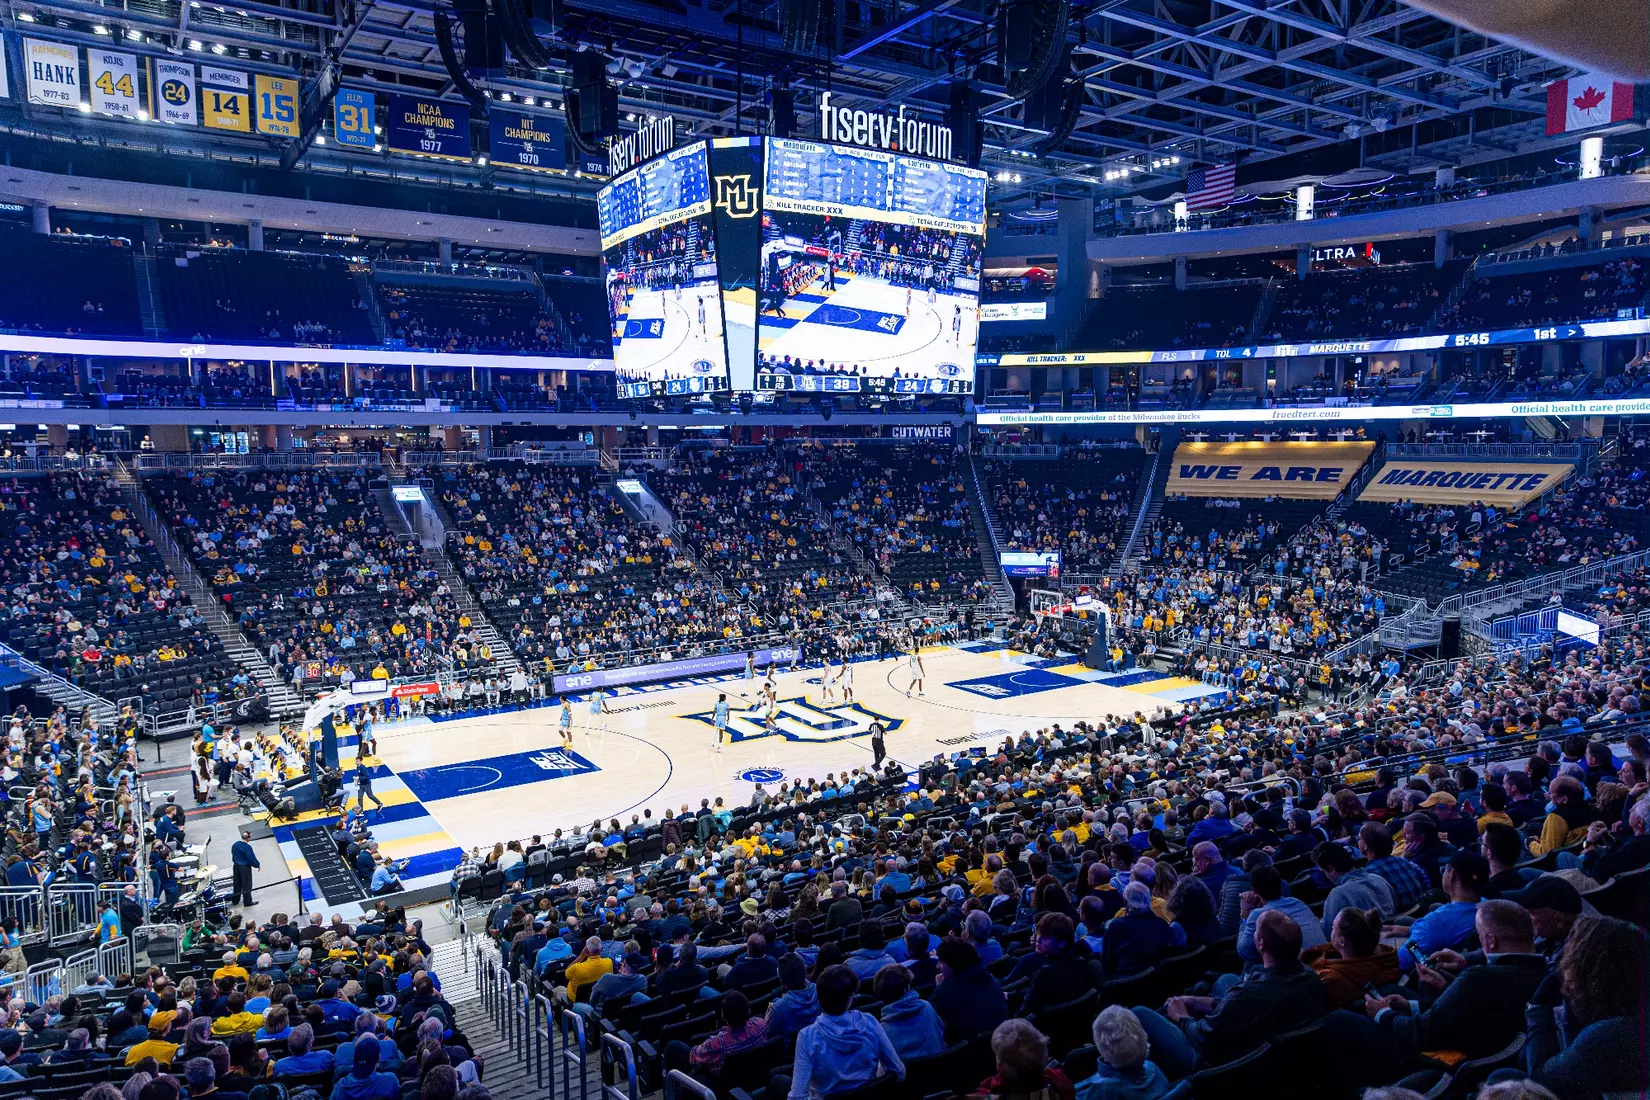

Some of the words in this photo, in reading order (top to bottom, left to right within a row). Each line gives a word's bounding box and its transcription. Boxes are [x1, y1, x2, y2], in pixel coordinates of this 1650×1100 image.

[32, 46, 73, 59] RAYMONDS
[103, 55, 124, 67] KOJIS
[33, 61, 75, 85] HANK
[159, 65, 190, 77] THOMPSON
[95, 71, 135, 98] 44
[209, 73, 241, 85] MEMINGER
[165, 83, 187, 102] 24
[271, 82, 283, 91] LEE
[212, 93, 240, 115] 14
[346, 94, 362, 103] ELLIS
[104, 102, 129, 112] 1958-61
[261, 92, 295, 122] 15
[417, 103, 442, 116] NCAA
[165, 110, 190, 120] 1966-69
[340, 105, 371, 134] 31
[404, 112, 455, 130] CHAMPIONS
[521, 119, 534, 130] NIT
[505, 127, 551, 143] CHAMPIONS
[420, 139, 442, 152] 1977
[783, 141, 816, 152] MARQUETTE
[518, 152, 539, 165] 1970
[586, 162, 602, 172] 1974
[827, 207, 843, 215] XXX
[1455, 333, 1490, 346] 5:45
[1533, 327, 1557, 340] 1st
[1161, 352, 1177, 360] FLS
[1216, 350, 1231, 358] TOL
[1242, 348, 1251, 357] 4
[1309, 342, 1371, 354] MARQUETTE
[1026, 355, 1039, 363] KILL
[904, 381, 918, 391] 24
[1511, 404, 1549, 413] Official
[1552, 403, 1586, 412] health
[1589, 404, 1613, 412] care
[1000, 414, 1027, 422] Official
[1030, 413, 1054, 422] health
[1074, 414, 1106, 424] provider
[1108, 413, 1117, 421] of
[1118, 413, 1131, 421] the
[1132, 412, 1175, 420] Milwaukee
[1272, 410, 1340, 419] froedtert.com
[892, 426, 952, 438] CUTWATER
[1179, 465, 1242, 480] WE
[1250, 466, 1344, 482] ARE
[1378, 469, 1549, 491] MARQUETTE
[771, 648, 793, 660] one
[307, 669, 318, 677] 30
[565, 675, 592, 688] one
